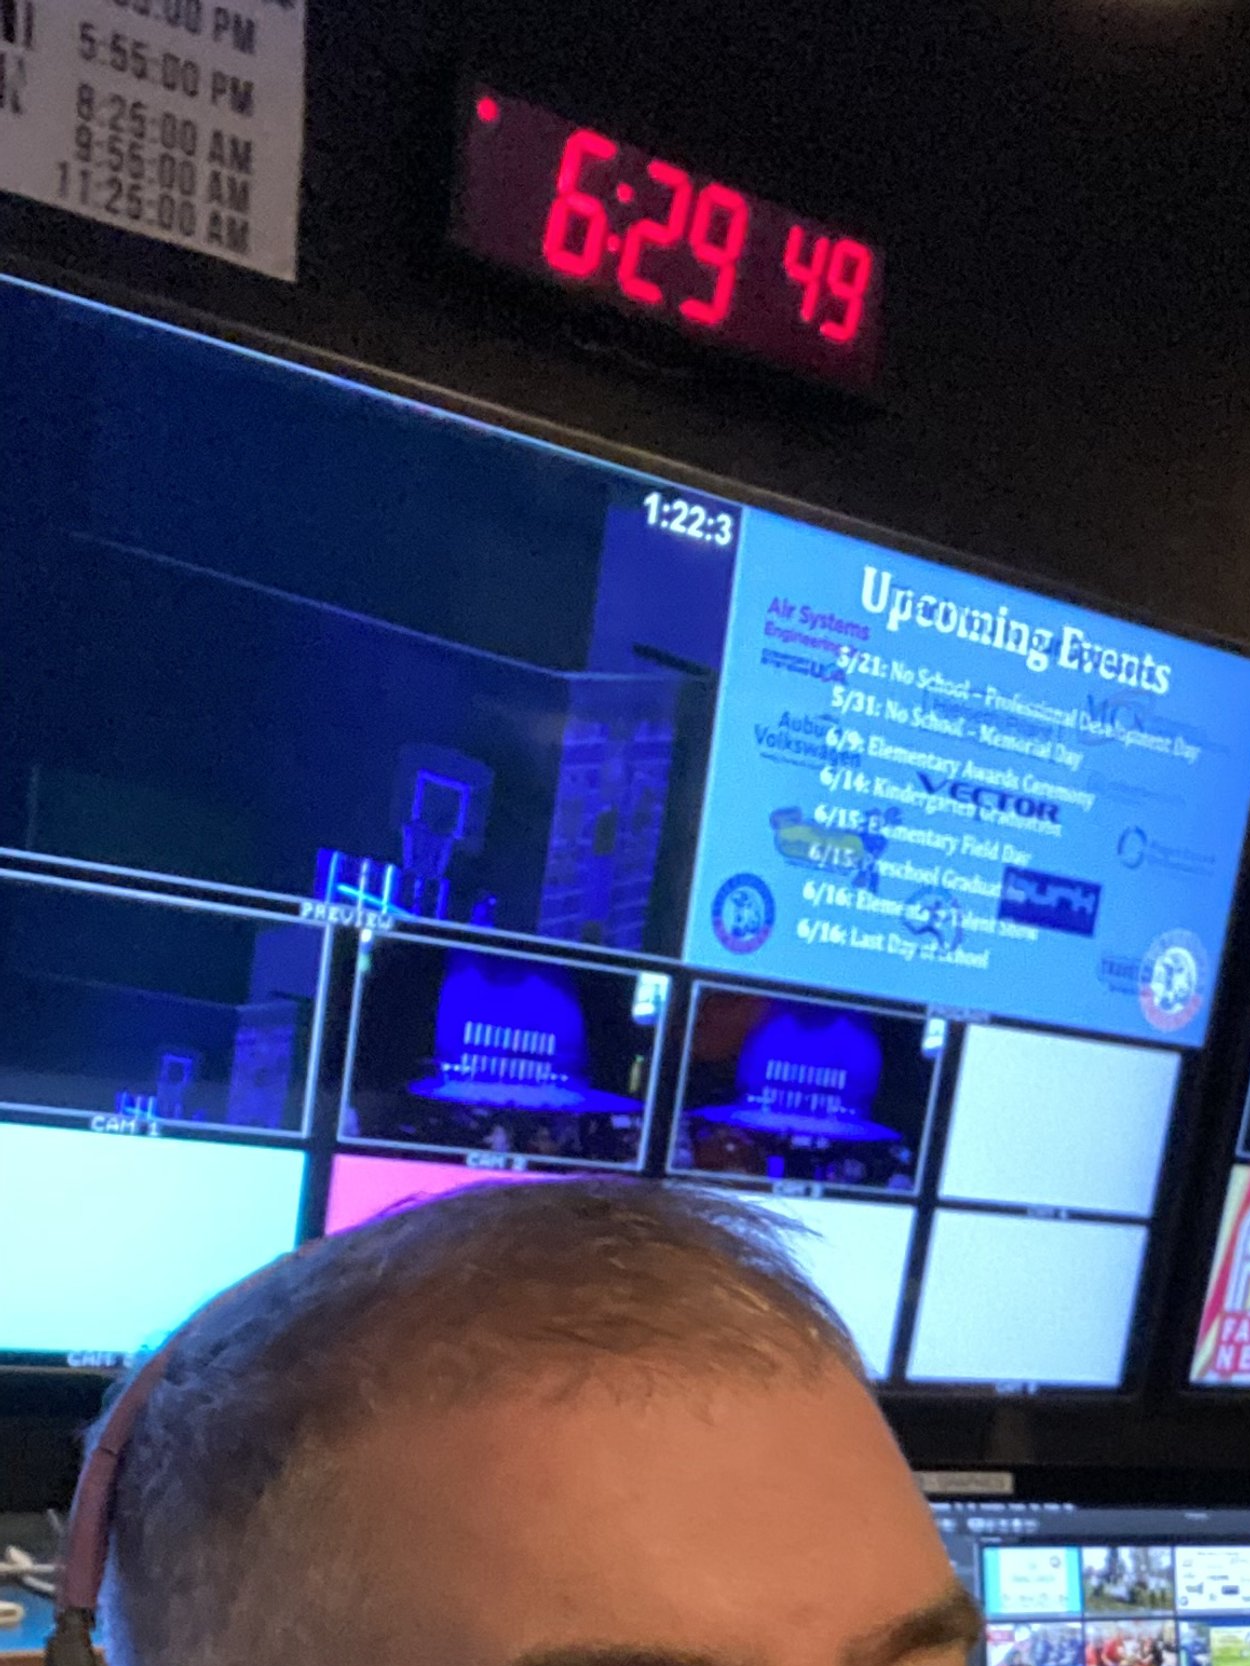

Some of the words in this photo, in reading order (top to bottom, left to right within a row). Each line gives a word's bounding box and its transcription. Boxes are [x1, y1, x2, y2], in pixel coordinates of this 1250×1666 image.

[213, 6, 255, 54] PM
[79, 21, 200, 98] 5:55:00
[211, 70, 254, 117] PM
[76, 83, 197, 157] 8:25:00
[208, 129, 252, 175] AM
[75, 122, 196, 197] 9:55:00
[208, 169, 249, 214] AM
[57, 160, 196, 237] 11:25:00
[207, 209, 249, 255] AM
[543, 129, 749, 325] 6:29
[784, 225, 872, 341] 49
[644, 492, 732, 546] 1:22:3
[767, 596, 797, 619] Air
[799, 604, 870, 641] Systems
[861, 565, 1053, 672] Upcoming
[1057, 626, 1171, 694] Events
[890, 661, 914, 685] No
[917, 668, 970, 700] School
[831, 684, 881, 714] 5/31:
[884, 700, 908, 723] No
[911, 706, 965, 738] School
[979, 724, 1052, 759] Memorial
[1055, 742, 1084, 771] Day
[867, 735, 961, 779] Elementary
[962, 760, 1020, 790] Awards
[915, 771, 1060, 824] VECTOR
[302, 901, 394, 930] PREVIEW
[850, 927, 884, 951] Last
[887, 934, 918, 961] Day
[91, 1115, 137, 1134] CAM
[148, 1121, 160, 1137] 1
